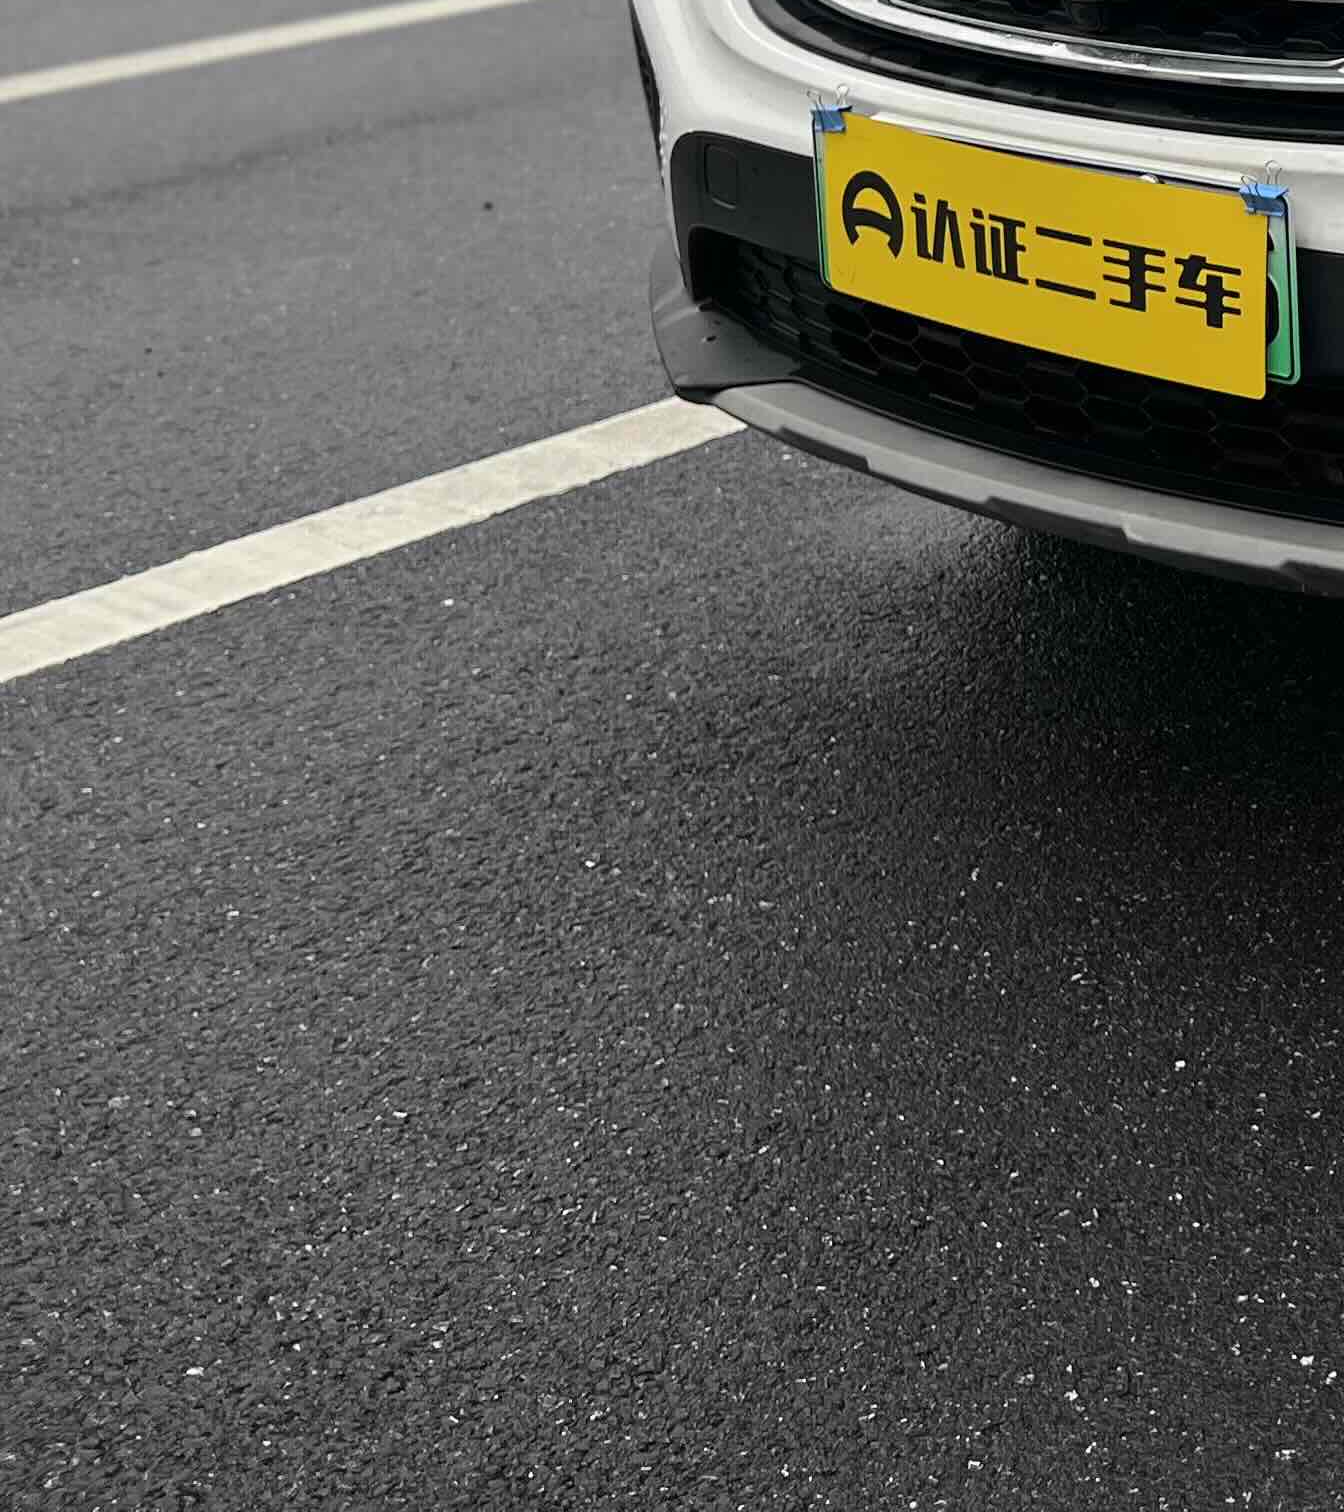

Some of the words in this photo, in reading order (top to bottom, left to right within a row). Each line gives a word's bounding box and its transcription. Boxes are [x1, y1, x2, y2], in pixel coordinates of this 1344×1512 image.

[910, 192, 1242, 329] 认证二手车
